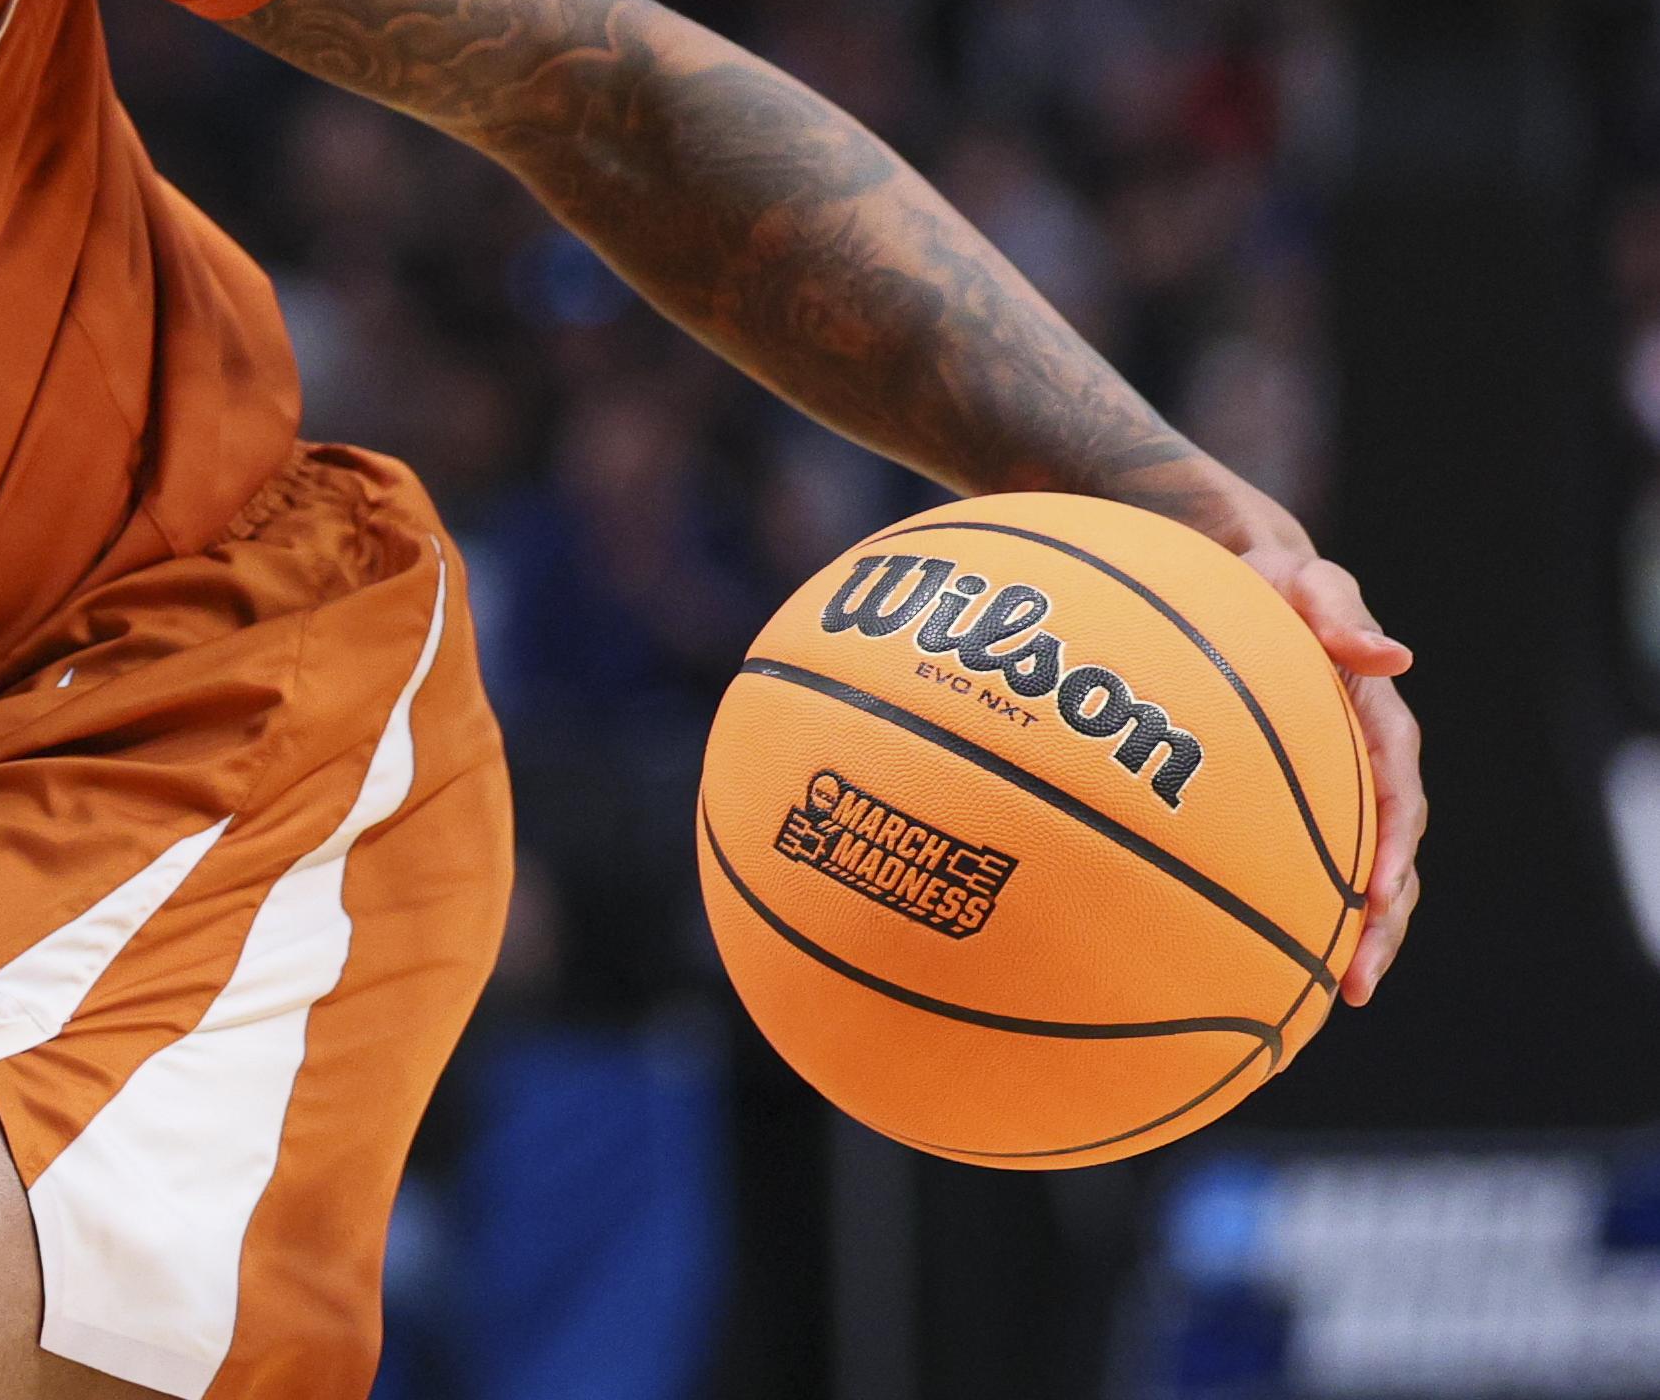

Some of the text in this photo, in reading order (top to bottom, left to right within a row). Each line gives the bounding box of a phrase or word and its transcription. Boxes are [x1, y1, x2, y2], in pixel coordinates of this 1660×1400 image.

[819, 554, 1204, 814] Wilson
[915, 661, 1040, 728] EVO NXT
[831, 790, 951, 871] MARCH
[830, 831, 990, 930] MADNESS
